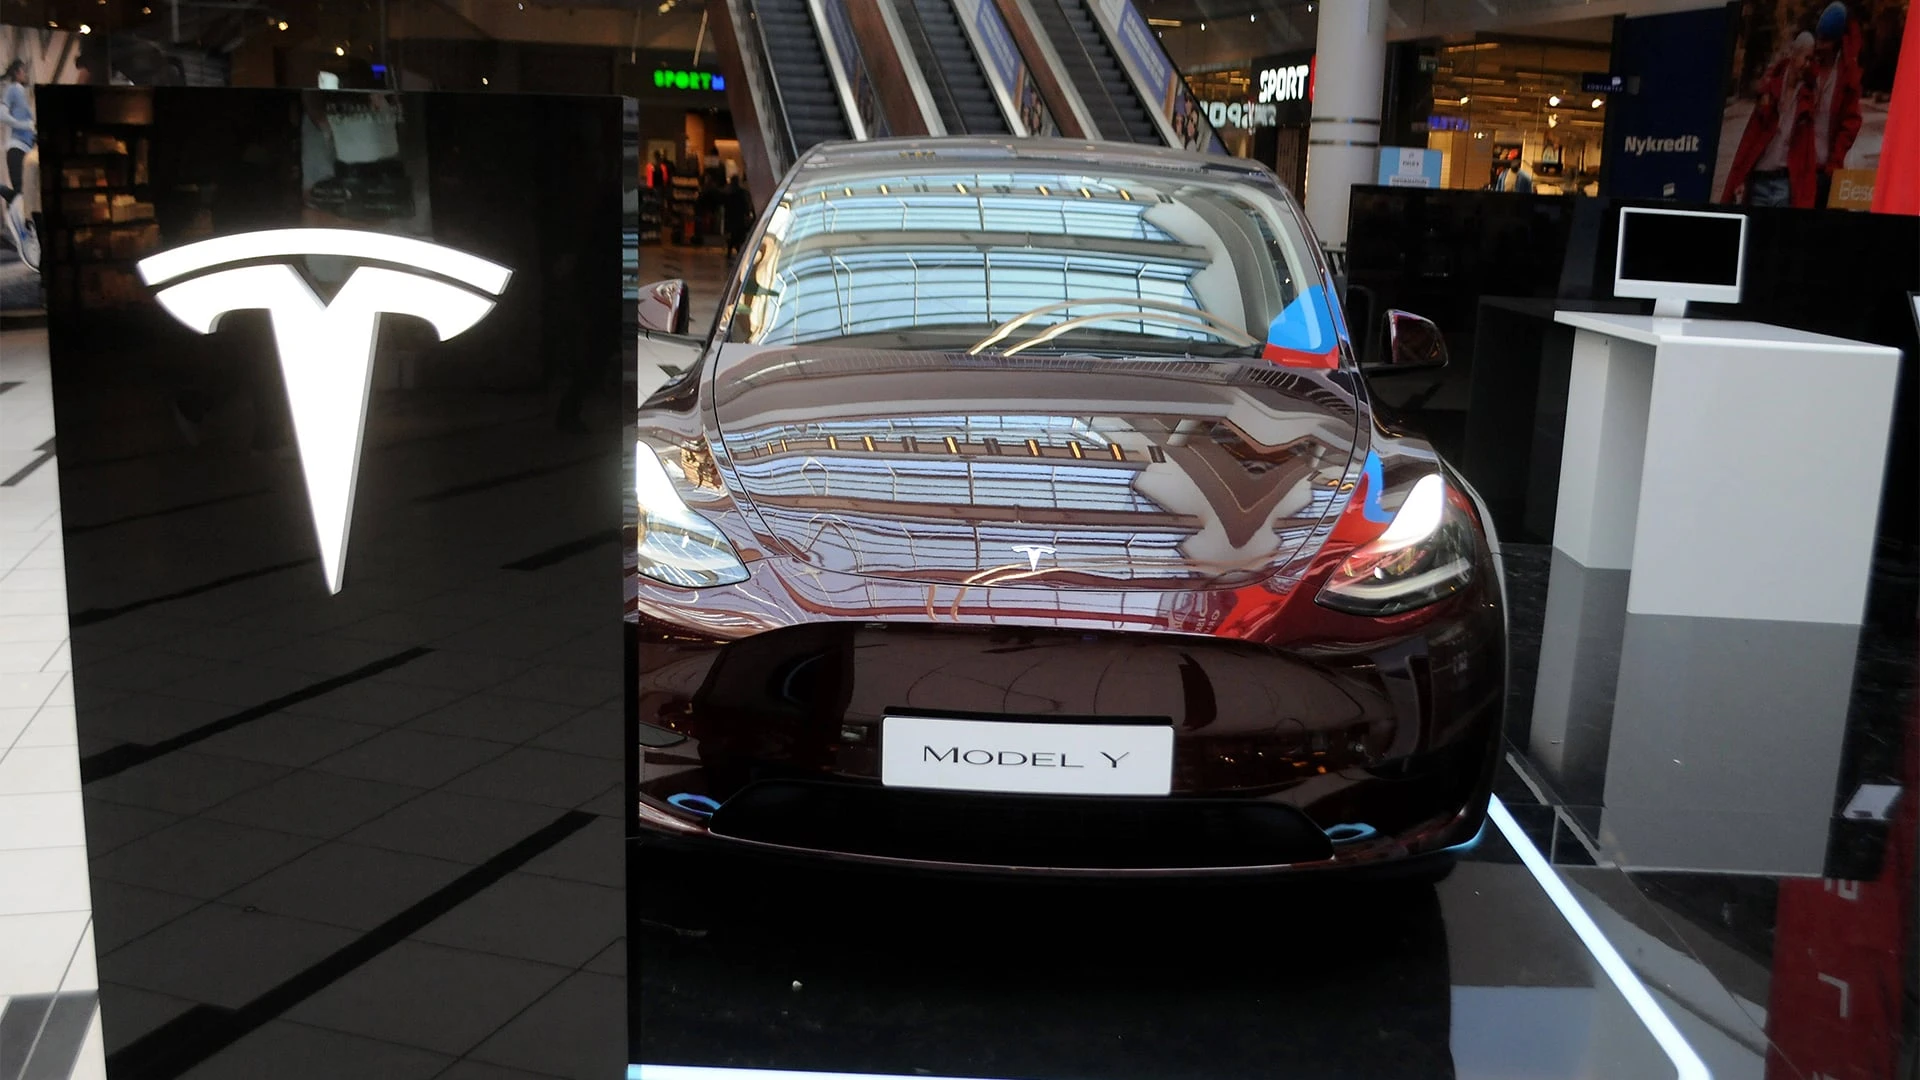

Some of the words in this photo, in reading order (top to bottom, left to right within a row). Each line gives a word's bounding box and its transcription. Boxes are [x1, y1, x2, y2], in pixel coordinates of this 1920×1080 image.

[1259, 65, 1309, 103] SPORT
[1624, 135, 1700, 156] Nykredit
[924, 744, 1084, 769] MODEL
[1100, 751, 1130, 768] Y
